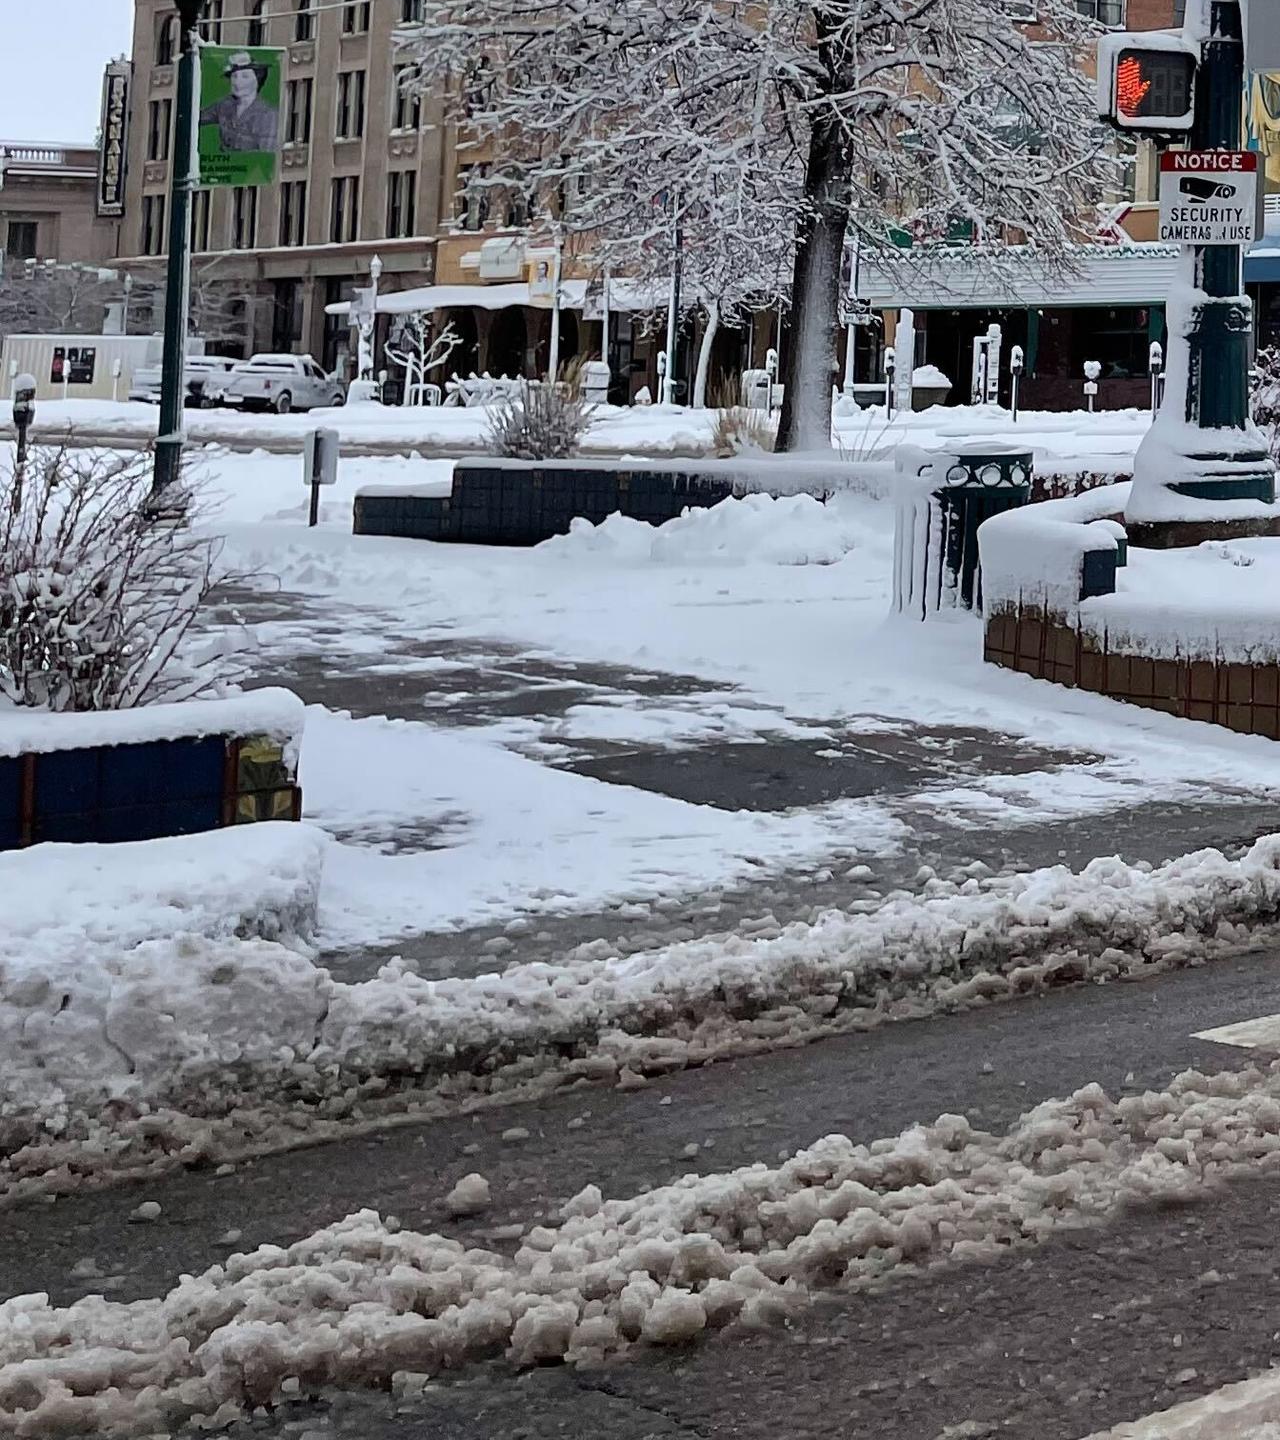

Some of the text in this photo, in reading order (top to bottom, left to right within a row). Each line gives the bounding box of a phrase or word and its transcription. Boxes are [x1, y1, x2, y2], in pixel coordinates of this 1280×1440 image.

[1174, 154, 1243, 169] NOTICE
[1171, 207, 1243, 222] SECURITY
[1161, 225, 1211, 240] CAMERAS
[1230, 225, 1251, 240] USE
